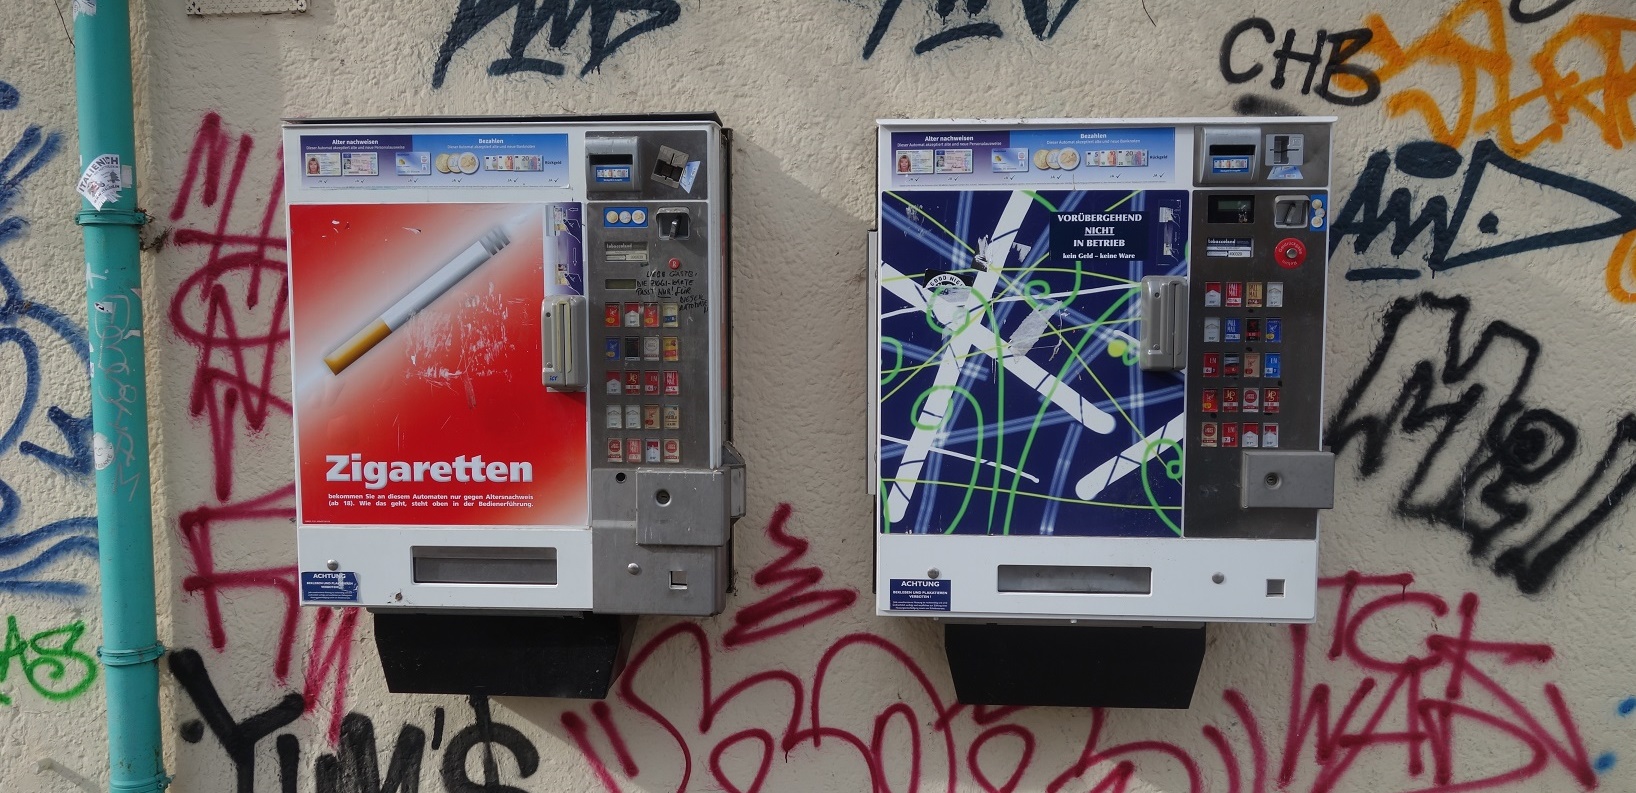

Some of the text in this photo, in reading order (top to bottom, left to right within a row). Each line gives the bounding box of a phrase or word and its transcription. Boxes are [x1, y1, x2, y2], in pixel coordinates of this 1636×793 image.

[1057, 213, 1142, 222] VORÜBERGEHEND
[1084, 227, 1115, 235] NICHT
[1073, 239, 1125, 247] IN BETRIEB
[325, 453, 533, 489] Zigaretten
[478, 500, 534, 508] Bedienerführung.
